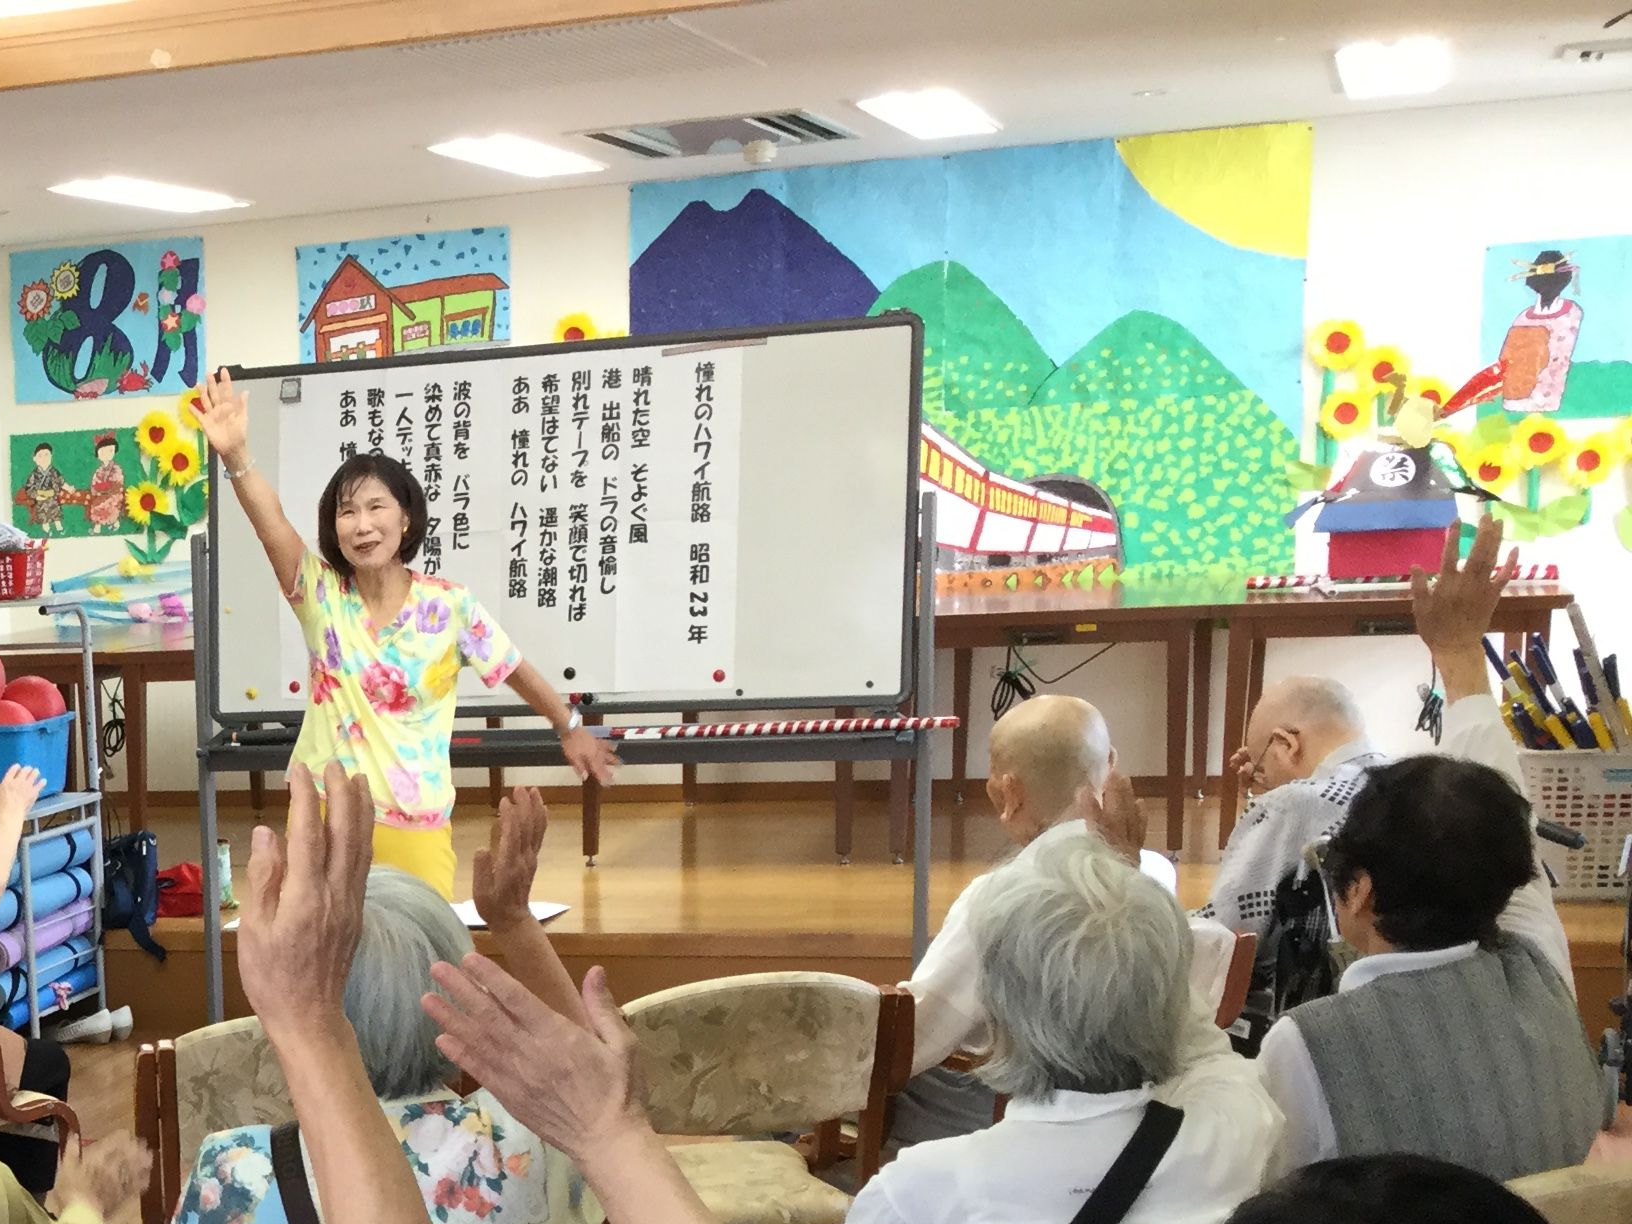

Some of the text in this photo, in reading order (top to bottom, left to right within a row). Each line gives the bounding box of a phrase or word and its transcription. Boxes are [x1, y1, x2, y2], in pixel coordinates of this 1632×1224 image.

[339, 390, 357, 428] ああ
[423, 382, 443, 576] 染めて真赤な 夕陽が
[452, 380, 472, 550] 波の背を バラ色に
[508, 375, 530, 599] ああ 憧れの ハワイ航路
[540, 373, 561, 493] 希望はてない
[568, 370, 591, 622] 別れテープを 笑顔で切れば
[598, 368, 622, 595] 港 出船の ドラの音愉し
[628, 365, 653, 544] 晴れた空 そよぐ風
[691, 361, 714, 523] 憧れのハワイ航路
